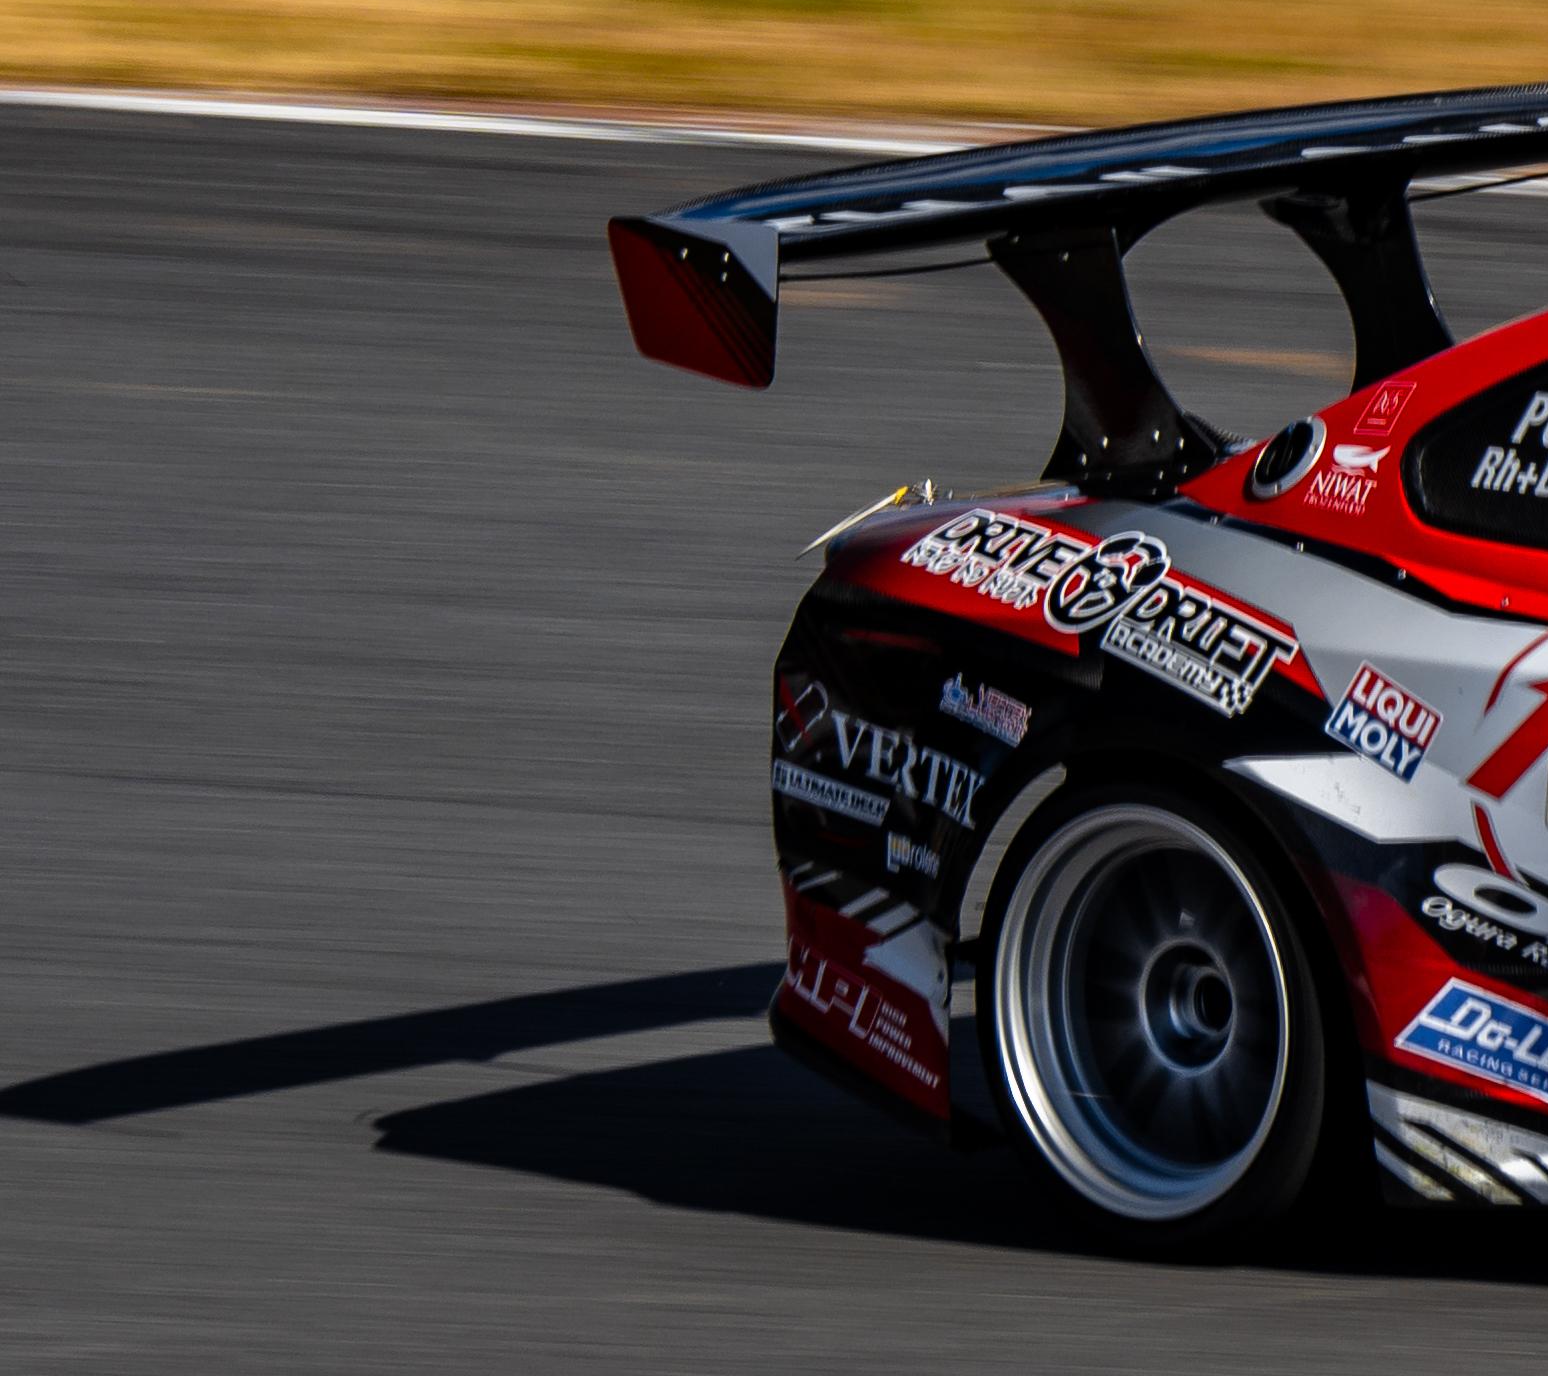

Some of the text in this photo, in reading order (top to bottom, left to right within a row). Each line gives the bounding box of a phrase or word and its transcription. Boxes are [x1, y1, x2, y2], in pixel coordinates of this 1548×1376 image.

[1309, 470, 1378, 505] NIWAT
[922, 509, 1094, 586] DRIVE
[1110, 622, 1223, 694] ACADEMY
[1119, 579, 1300, 686] DRIFT
[1332, 703, 1422, 778] MOLY
[1350, 670, 1436, 745] LIQUI
[831, 710, 986, 830] VERTEX
[1421, 896, 1518, 952] Ogura
[868, 1034, 941, 1089] IMPROVEMENT
[875, 1015, 912, 1048] POWER
[1438, 1038, 1514, 1080] RACING
